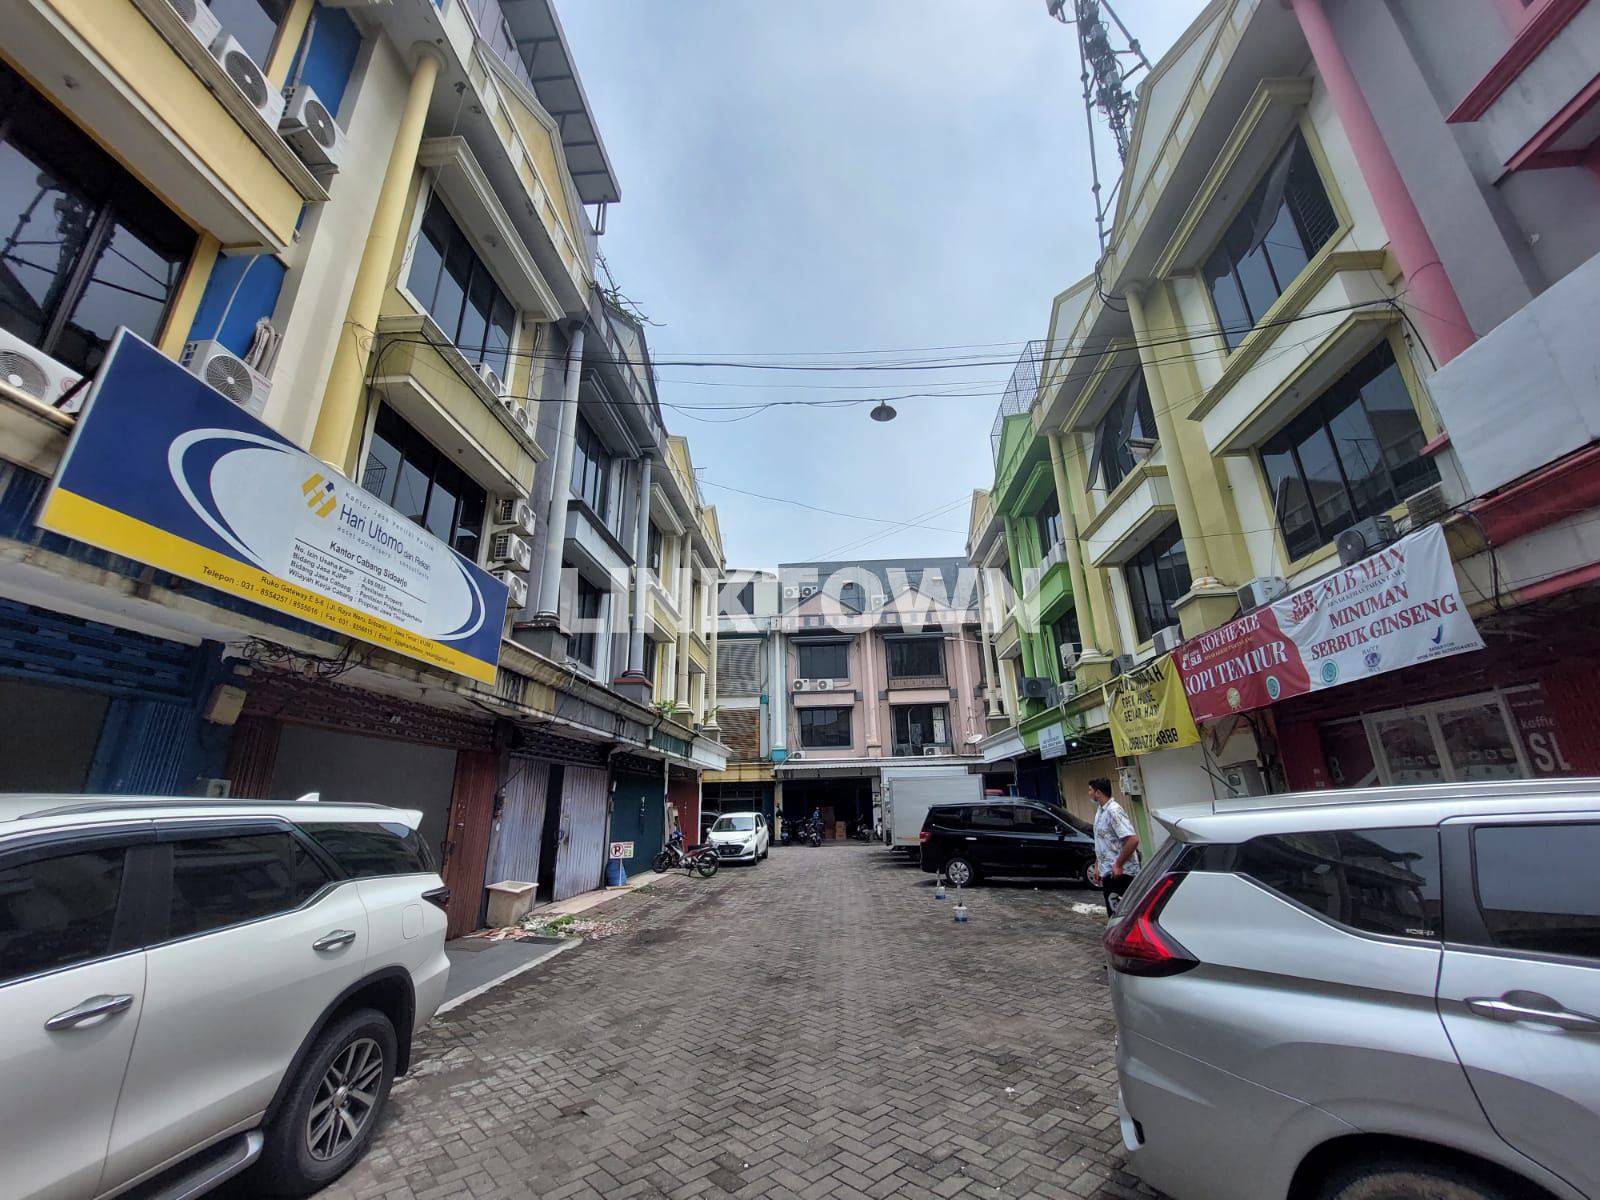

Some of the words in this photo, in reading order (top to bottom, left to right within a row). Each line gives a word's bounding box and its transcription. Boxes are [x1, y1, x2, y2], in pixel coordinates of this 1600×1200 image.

[340, 503, 366, 532] Hari
[368, 519, 404, 554] Utomo
[290, 559, 313, 577] Bidang
[314, 571, 329, 582] Jasa
[330, 577, 352, 593] Cabang
[293, 551, 315, 569] Bidang
[316, 563, 331, 574] Jasa
[331, 570, 348, 581] KJPP
[319, 556, 338, 570] Usaha
[330, 540, 356, 560] Kantor
[356, 554, 382, 576] Cabang
[383, 568, 408, 589] Sidoarjo
[1359, 547, 1405, 584] MAN
[202, 565, 235, 584] Telepon
[240, 580, 255, 592] 031
[261, 576, 280, 589] Ruko
[280, 583, 308, 601] Gateway
[315, 579, 332, 591] Kerja
[1291, 589, 1313, 610] SLB
[1329, 582, 1408, 630] MINUMAN
[1238, 613, 1261, 637] SLB
[1310, 626, 1369, 661] SERBUK
[1369, 592, 1458, 640] GINSENG
